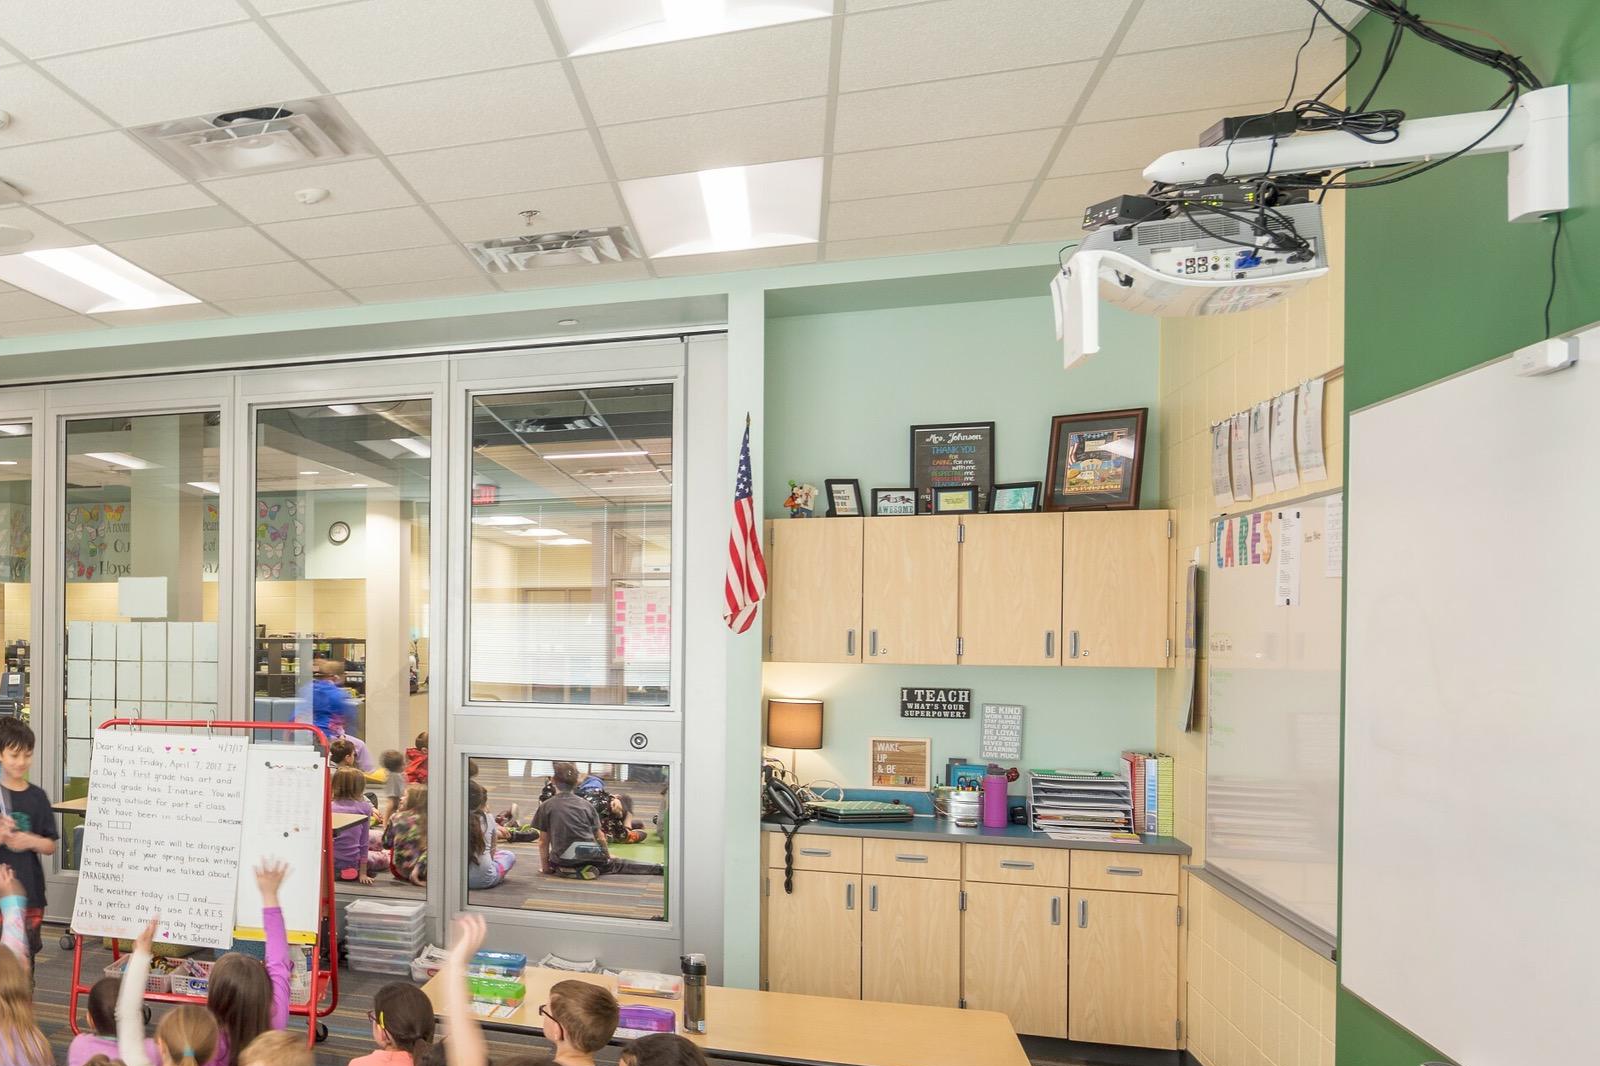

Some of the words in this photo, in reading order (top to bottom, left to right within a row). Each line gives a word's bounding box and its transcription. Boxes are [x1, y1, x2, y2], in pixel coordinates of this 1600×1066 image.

[947, 432, 983, 444] Johnson
[932, 446, 959, 454] THANK
[1216, 512, 1272, 568] CARES
[902, 689, 908, 701] I
[914, 690, 969, 702] TEACH
[877, 743, 900, 752] WAKE
[104, 755, 123, 766] Today
[170, 760, 189, 770] April
[877, 753, 888, 763] UP
[103, 768, 117, 778] Day
[155, 773, 176, 782] grade
[886, 765, 896, 773] BE
[121, 784, 142, 792] grade
[212, 788, 224, 797] You
[102, 796, 121, 806] going
[87, 820, 103, 830] days
[100, 833, 115, 841] This
[118, 836, 151, 847] morning
[109, 849, 125, 858] copy
[163, 854, 184, 864] spring
[214, 858, 237, 869] writing
[95, 860, 113, 870] ready
[144, 864, 161, 872] what
[181, 868, 205, 876] talked
[94, 885, 103, 893] The
[142, 891, 163, 901] today
[136, 904, 149, 913] day
[174, 920, 186, 931] day
[191, 922, 223, 933] together!
[191, 934, 219, 944] Johnson
